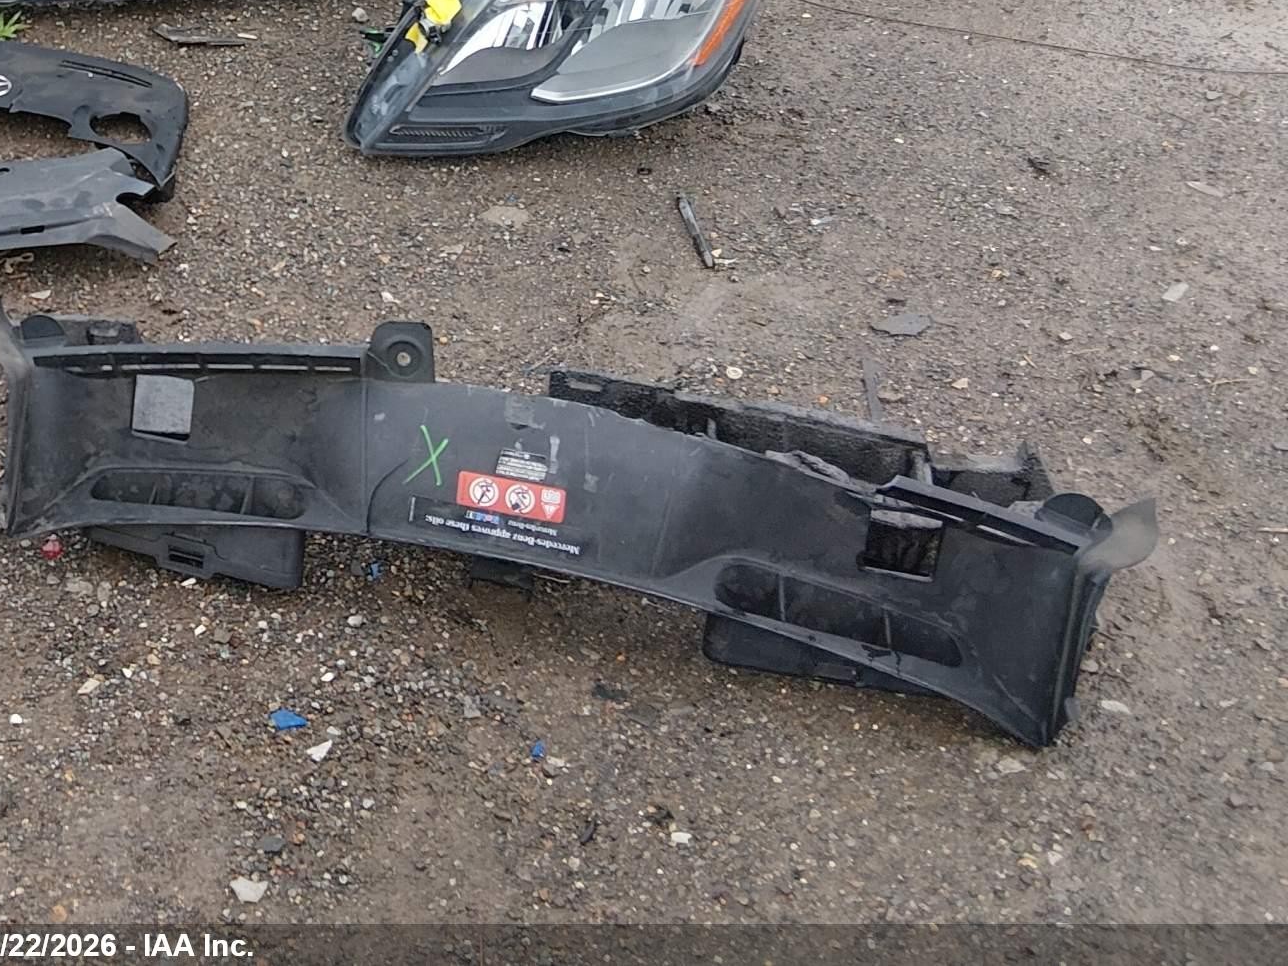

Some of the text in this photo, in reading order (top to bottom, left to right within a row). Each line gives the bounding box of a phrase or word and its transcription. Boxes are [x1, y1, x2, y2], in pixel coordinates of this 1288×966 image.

[445, 519, 470, 532] these
[471, 523, 511, 540] approves
[512, 533, 580, 555] Mercedes-Benz
